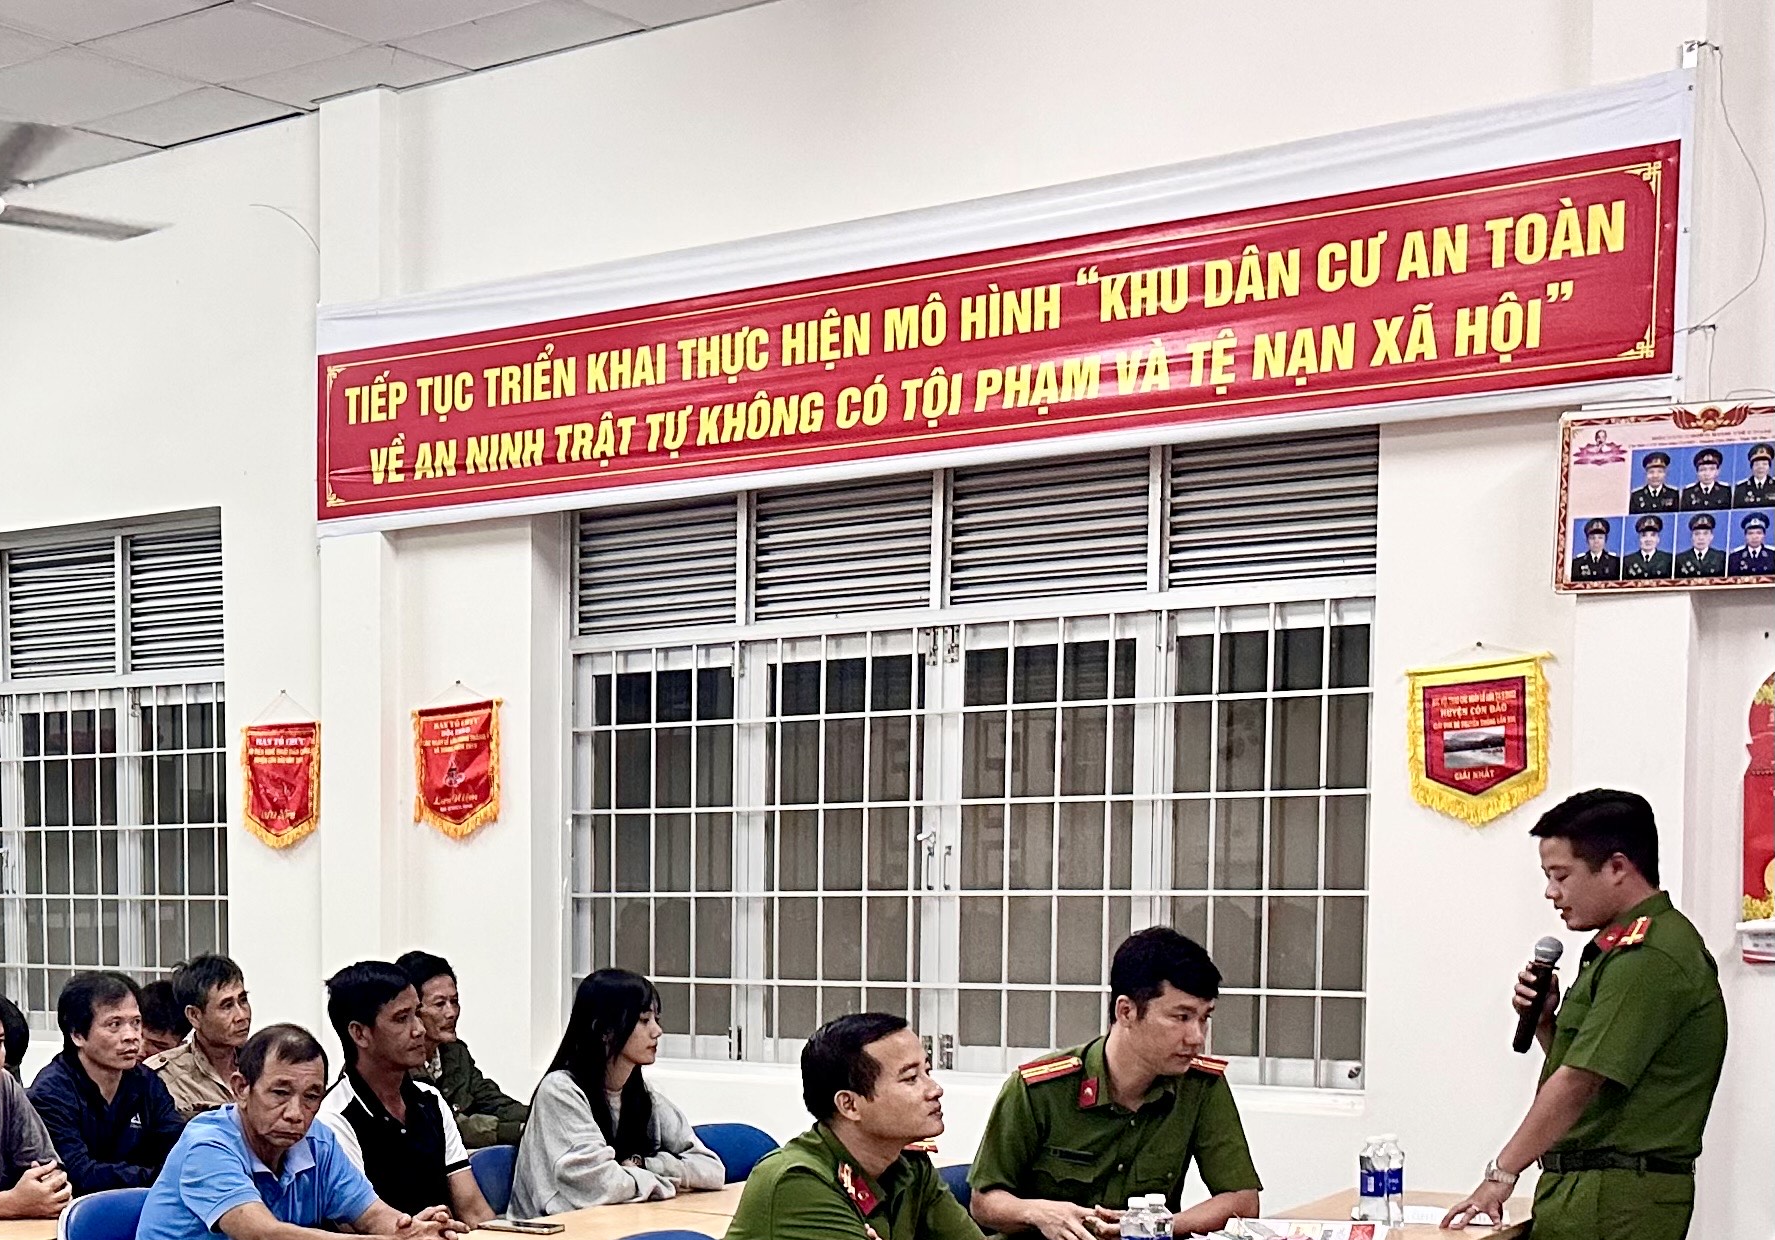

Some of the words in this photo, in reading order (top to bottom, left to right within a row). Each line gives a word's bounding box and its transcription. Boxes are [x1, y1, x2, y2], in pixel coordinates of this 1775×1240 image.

[345, 364, 408, 425] TIẾP
[417, 376, 474, 420] TỤC
[483, 343, 577, 409] TRIỂN
[586, 345, 667, 394] KHAI
[677, 327, 771, 384] THỰC
[781, 308, 872, 369] HIỆN
[883, 293, 947, 351] MÔ
[960, 282, 1062, 343] HÌNH
[1203, 244, 1301, 309] DÂN
[1316, 230, 1389, 294] CƯ
[1396, 220, 1476, 282] AN
[1485, 196, 1626, 270] TOÀN
[369, 434, 406, 486] VỀ
[414, 440, 457, 482] AN
[465, 430, 545, 475] NINH
[554, 411, 638, 468] TRẬT
[646, 409, 692, 455] TỰ
[696, 391, 825, 447] KHÔNG
[836, 377, 887, 430] CÓ
[901, 363, 963, 429] TỘI
[974, 358, 1100, 416] PHẠM
[1116, 338, 1172, 396] VÀ
[1186, 327, 1237, 395] TỆ
[1251, 322, 1356, 387] NẠN
[1370, 302, 1437, 366] XÃ
